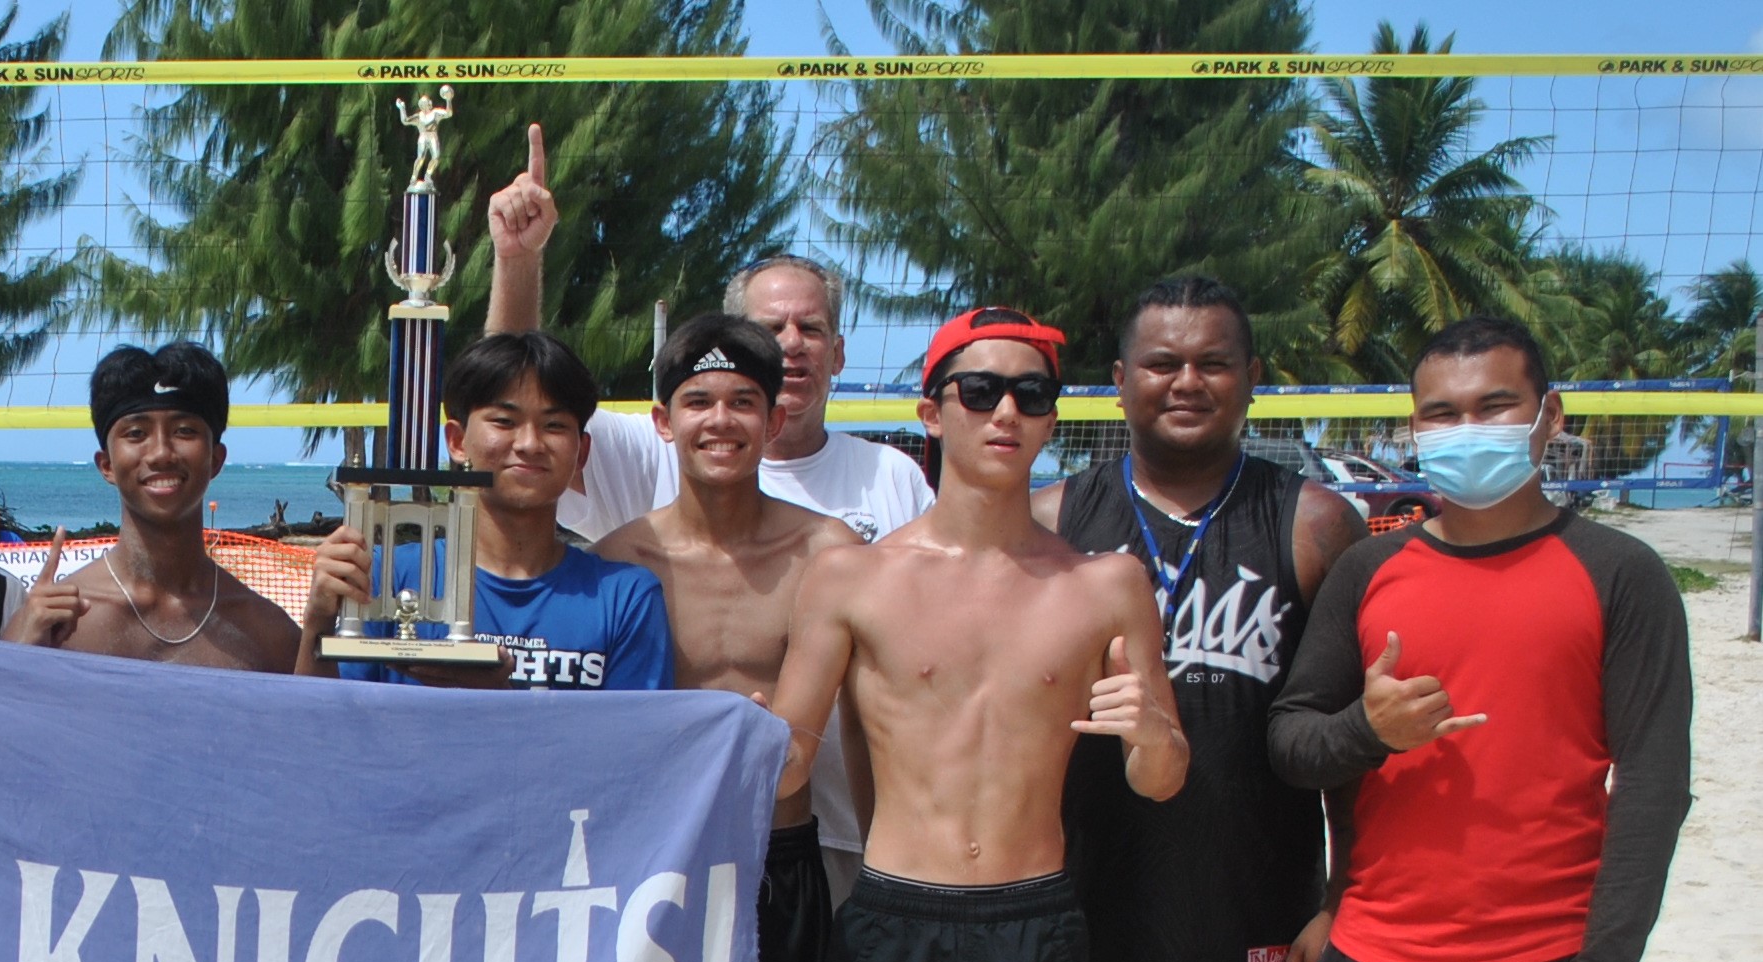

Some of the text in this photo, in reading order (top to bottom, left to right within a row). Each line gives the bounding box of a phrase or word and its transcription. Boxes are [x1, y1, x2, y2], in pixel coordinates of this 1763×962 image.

[380, 65, 430, 78] PARK
[435, 65, 449, 78] &
[799, 63, 849, 76] PARK
[854, 63, 868, 76] &
[1212, 61, 1262, 74] PARK
[1267, 61, 1280, 74] &
[1618, 60, 1667, 73] PARK
[1671, 60, 1684, 73] &
[14, 69, 29, 82] &
[693, 361, 735, 371] adidas
[1211, 672, 1226, 683] 07
